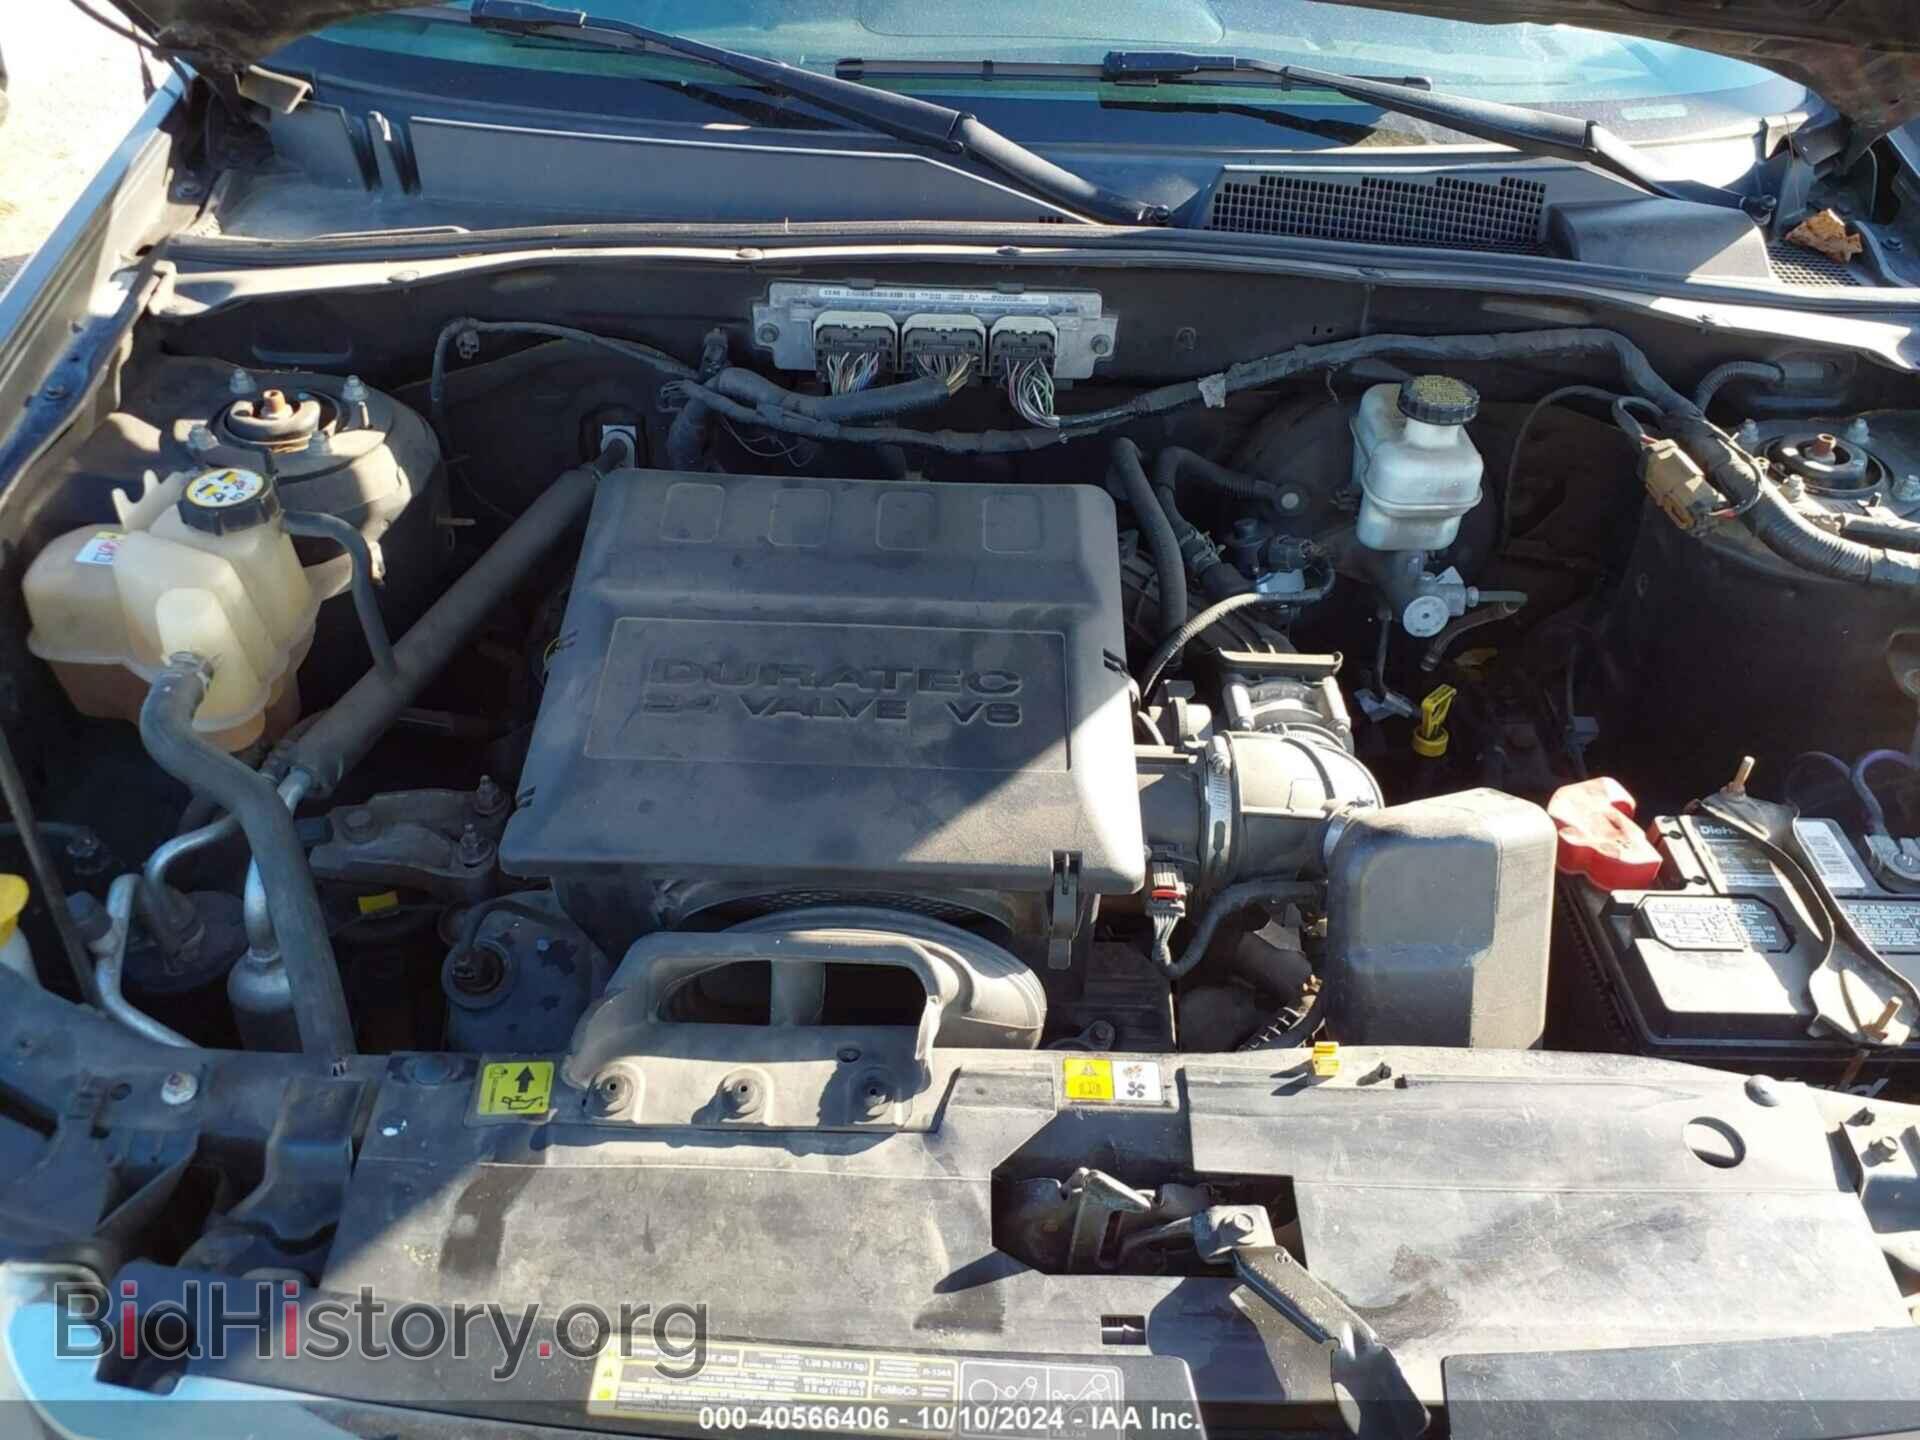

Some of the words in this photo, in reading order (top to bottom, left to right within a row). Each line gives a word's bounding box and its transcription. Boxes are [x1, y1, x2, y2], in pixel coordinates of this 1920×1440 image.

[649, 656, 1023, 698] DURATEC
[737, 692, 911, 723] VALVE
[944, 699, 1023, 728] V6
